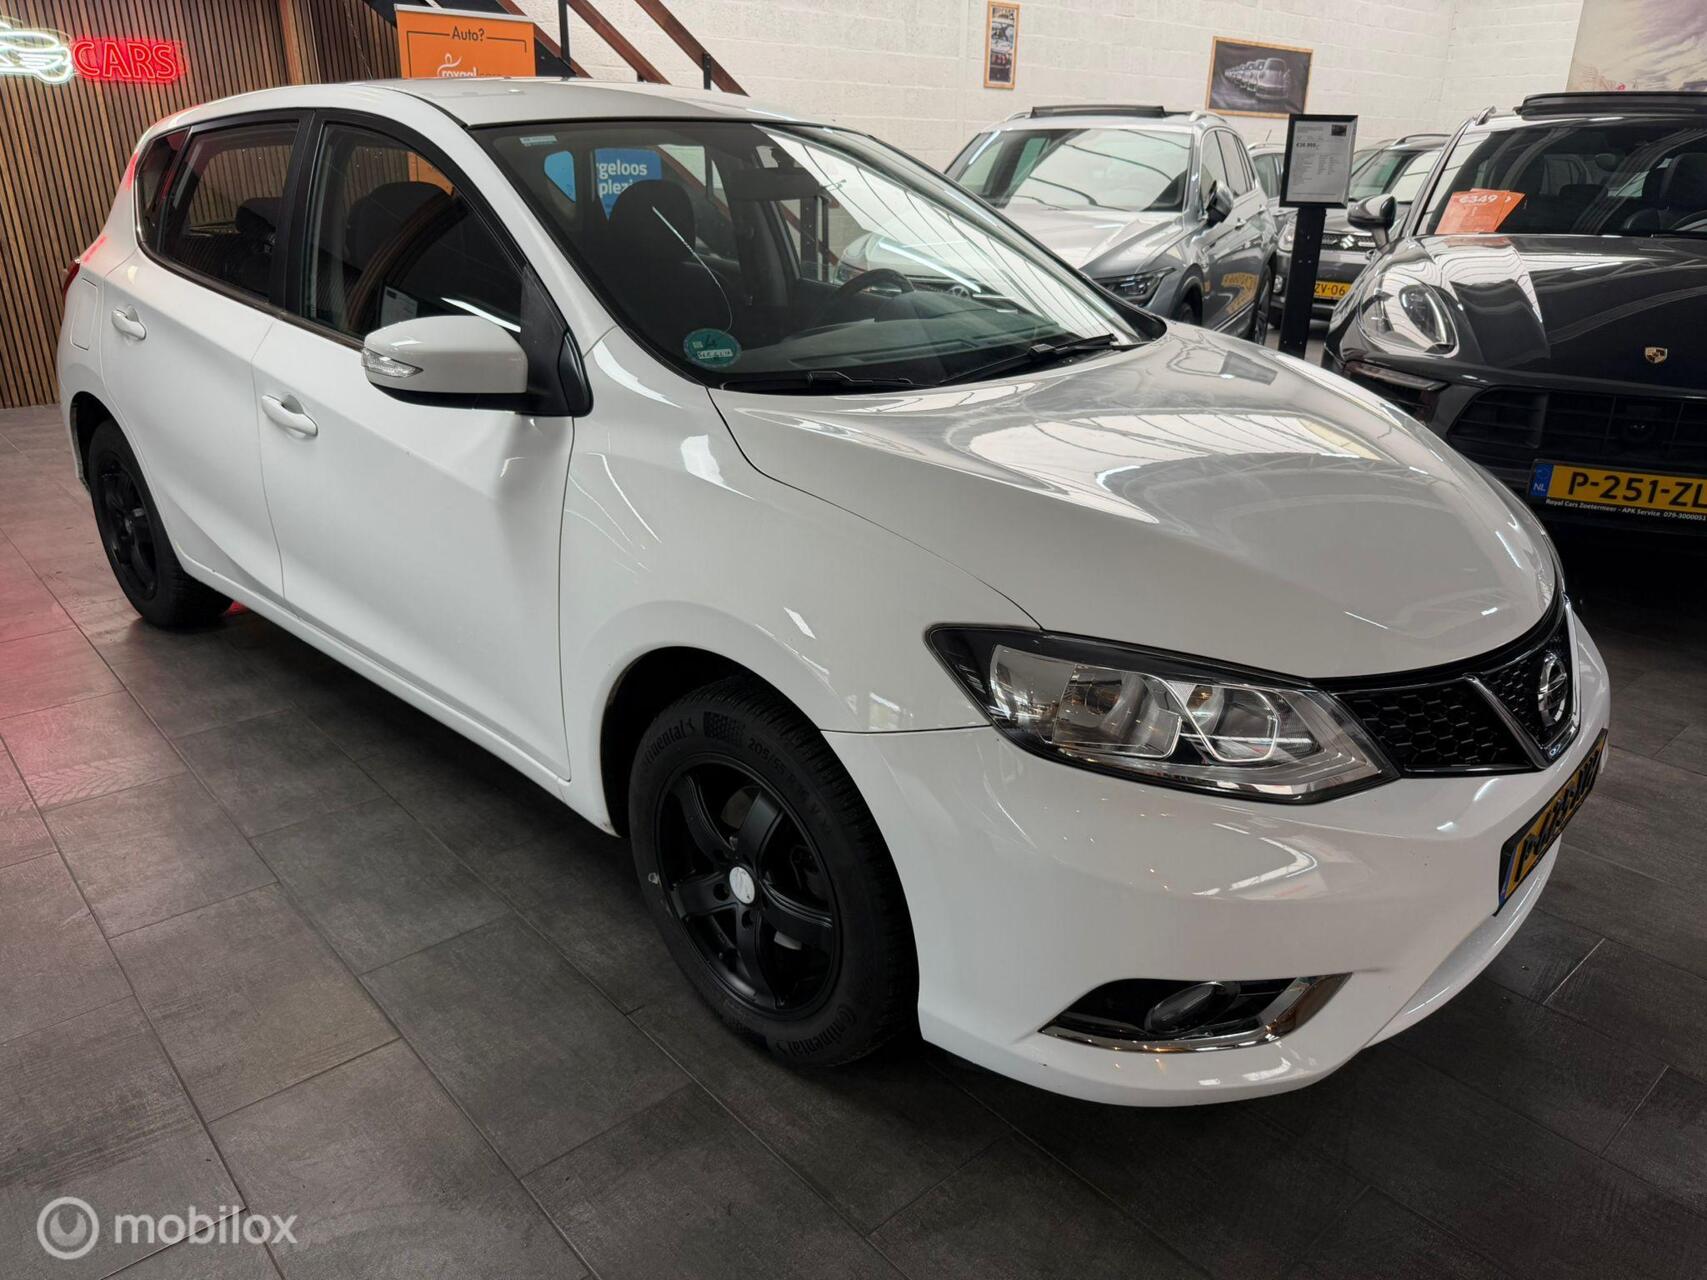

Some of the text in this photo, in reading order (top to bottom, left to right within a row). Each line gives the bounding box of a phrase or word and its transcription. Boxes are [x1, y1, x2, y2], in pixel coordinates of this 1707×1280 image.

[451, 25, 485, 42] Auto?
[72, 41, 177, 79] CARS
[596, 159, 648, 179] geloos
[599, 179, 633, 199] plez
[1533, 483, 1546, 492] NL
[1568, 471, 1707, 508] P-251-ZL
[1564, 500, 1579, 508] Cars
[1579, 502, 1617, 513] Zoetermeer
[1621, 507, 1636, 515] APK
[1636, 508, 1661, 518] Service
